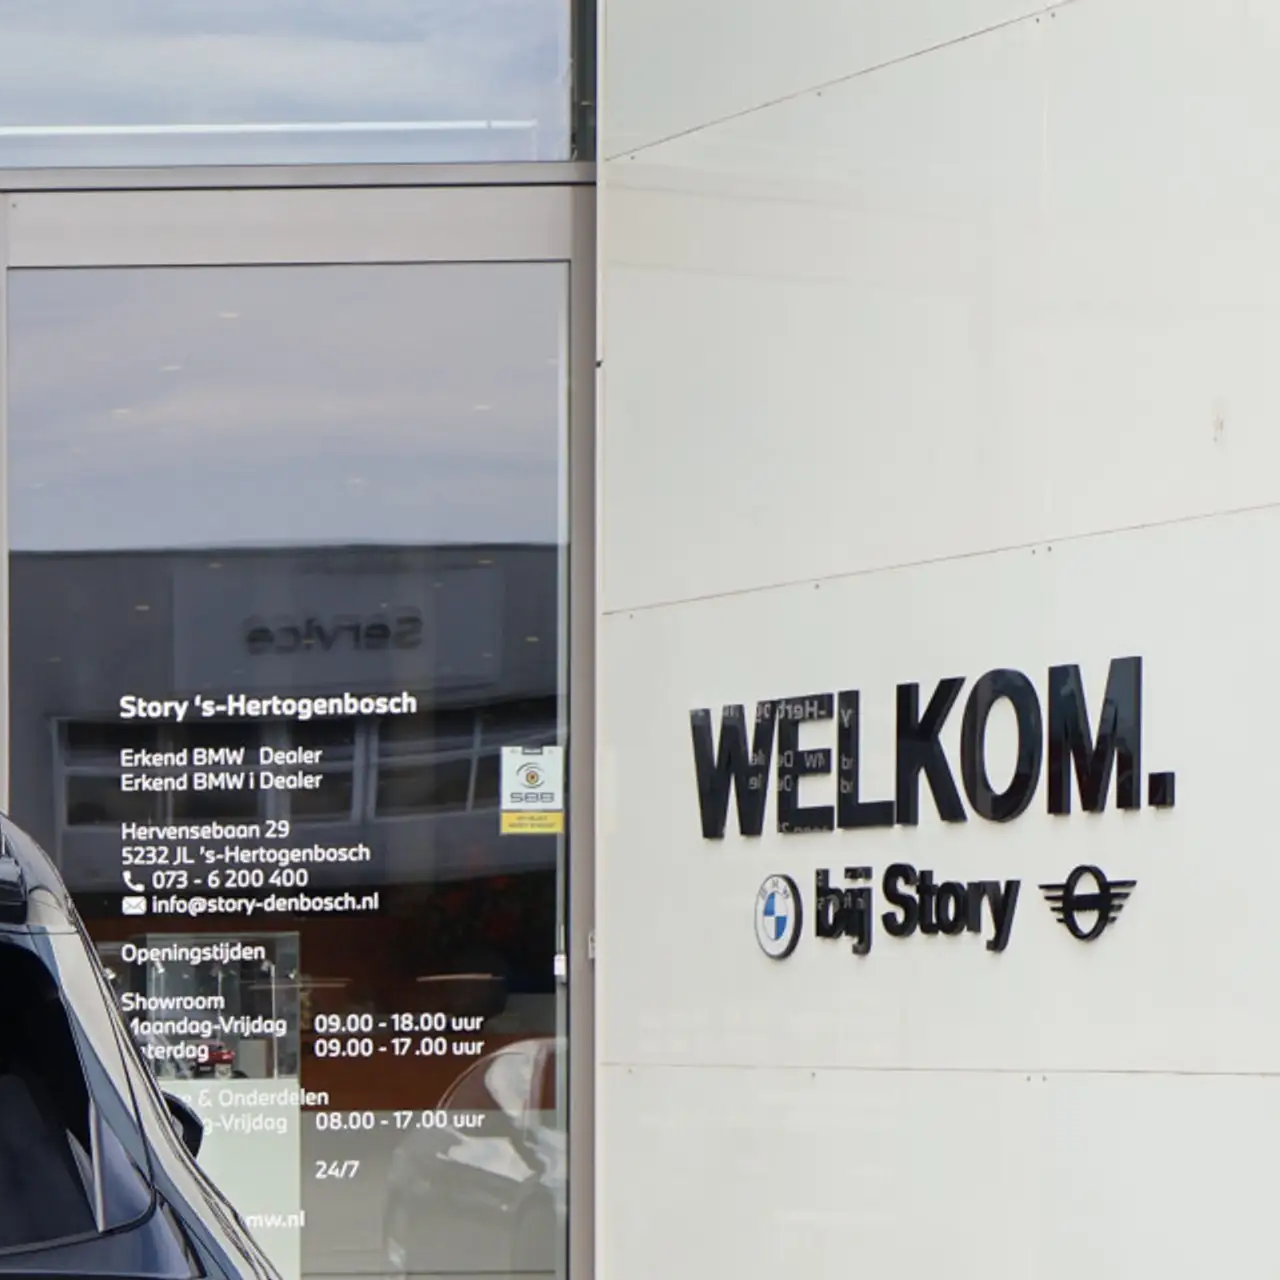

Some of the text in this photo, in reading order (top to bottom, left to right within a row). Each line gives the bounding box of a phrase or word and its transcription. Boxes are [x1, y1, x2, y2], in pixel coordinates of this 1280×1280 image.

[119, 696, 189, 722] Story
[120, 746, 323, 767] Erkend BMW Dealer
[690, 656, 1175, 838] WELKOM.
[121, 770, 323, 791] Erkend BMW i Dealer
[121, 820, 290, 841] Hervensebaan 29
[122, 846, 168, 865] 5232
[172, 846, 195, 866] JL
[152, 870, 188, 889] 073
[207, 869, 220, 889] 6
[225, 869, 264, 888] 200
[268, 868, 308, 887] 400
[151, 892, 379, 917] info@story-denbosch.nl
[815, 863, 1021, 955] bij Story
[121, 942, 266, 964] Openingstijden
[121, 992, 225, 1011] Showroom
[314, 1013, 373, 1033] 09.00
[391, 1012, 446, 1031] 18.00
[451, 1016, 484, 1031] uur
[142, 1041, 209, 1062] terdag
[314, 1038, 374, 1057] 09.00
[452, 1040, 485, 1056] uur
[219, 1088, 329, 1107] Onderdelen
[315, 1111, 375, 1131] 08.00
[453, 1113, 485, 1128] uur
[315, 1160, 360, 1179] 24/7
